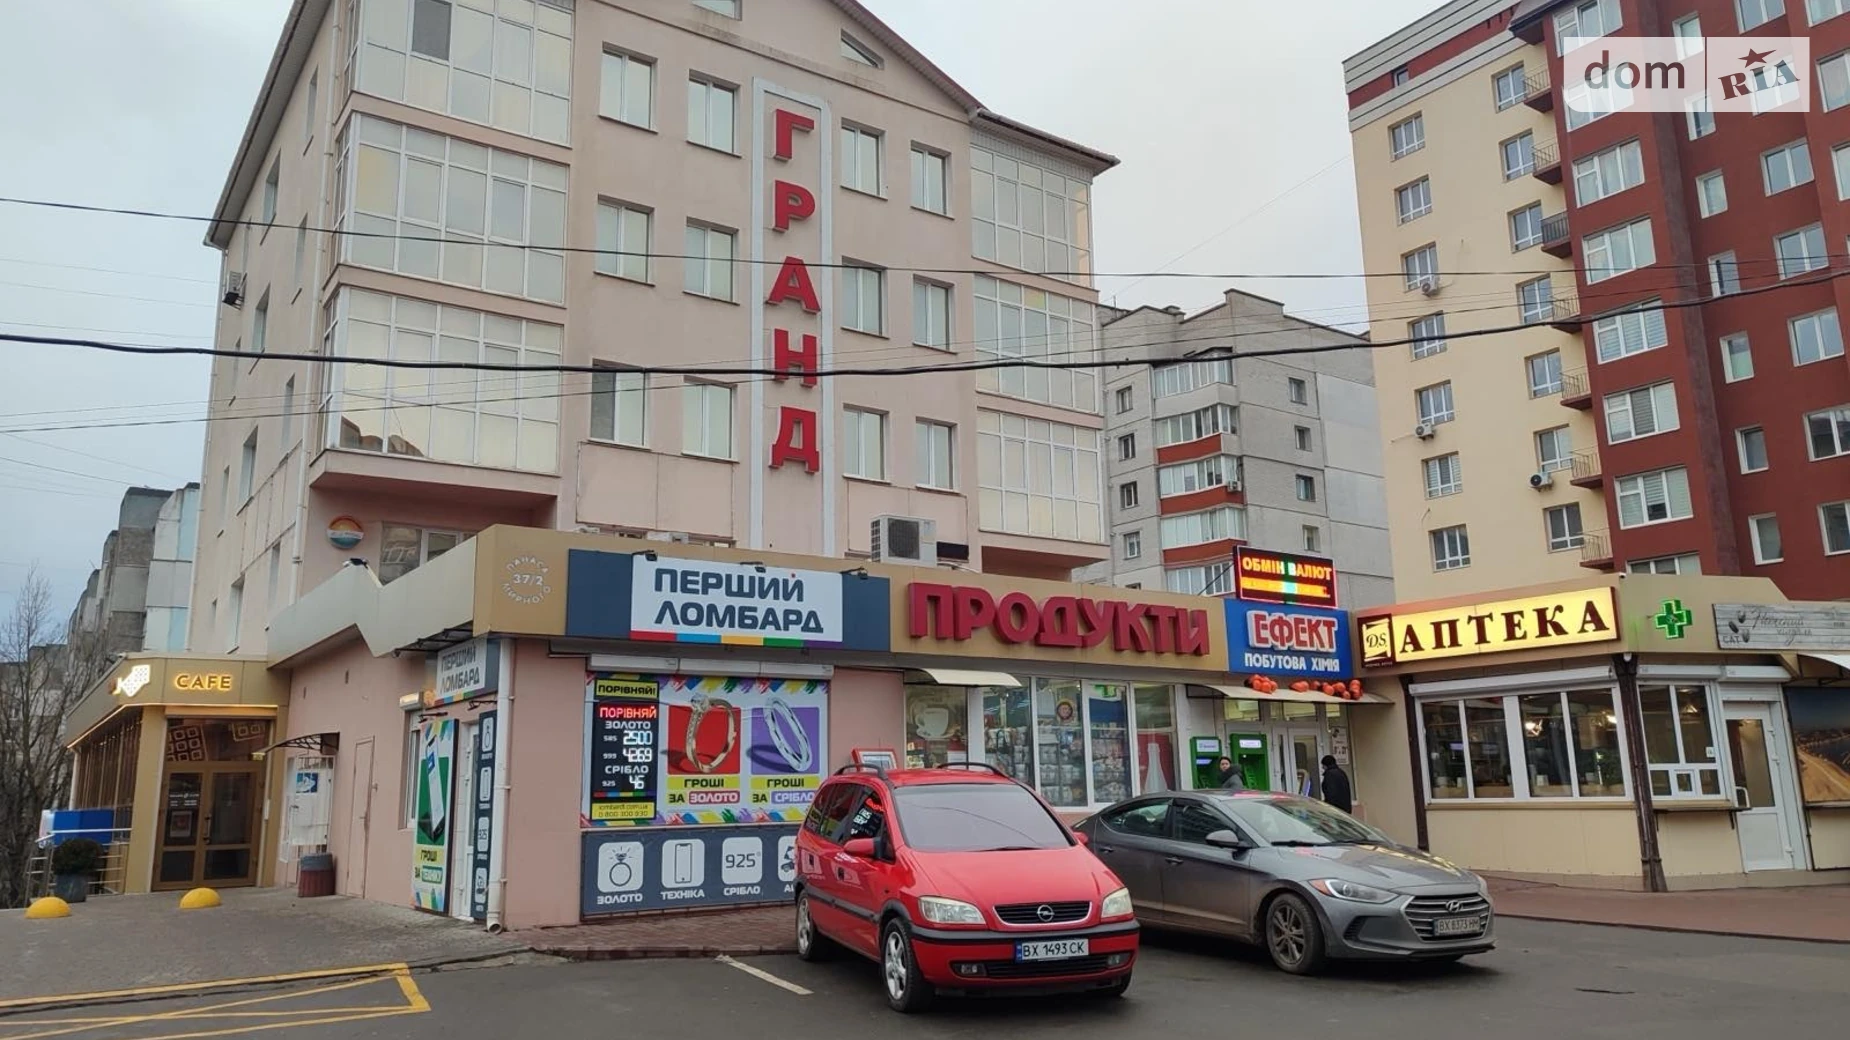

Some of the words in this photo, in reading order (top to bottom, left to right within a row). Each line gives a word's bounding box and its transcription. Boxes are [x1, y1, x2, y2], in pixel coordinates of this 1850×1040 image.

[765, 108, 821, 473] ГРАНД
[1242, 557, 1285, 575] ОБМІН
[1287, 562, 1332, 580] ВАЛЮТ
[513, 574, 543, 586] 37/2
[654, 568, 804, 602] ПЕРШИЙ
[654, 600, 824, 633] ЛОМБАРД
[907, 582, 1211, 656] ПРОДУКТИ
[1248, 611, 1338, 653] ЕФЕКТ
[1399, 599, 1610, 654] АПТЕКА
[441, 643, 476, 674] ПЕРШИЙ
[1244, 652, 1307, 671] ПОБУТОВА
[1311, 657, 1340, 673] ХІМІЯ
[176, 674, 232, 689] CAFE
[440, 667, 480, 694] ЛОМБАРД
[598, 684, 656, 696] ПОРІВНЯЙ!
[600, 706, 657, 719] ПОРІВНЯЙ
[605, 721, 651, 730] ЗОЛОТО
[605, 764, 649, 775] СРІБЛО
[684, 779, 724, 788] ГРОШІ
[767, 779, 804, 788] ГРОШІ
[669, 794, 685, 803] ЗА
[690, 792, 738, 803] ЗОЛОТО
[752, 794, 767, 803] ЗА
[775, 792, 815, 802] СРІБЛО
[661, 889, 705, 900] ТЕХНІКА
[723, 886, 761, 896] СРІБЛО
[597, 893, 643, 904] ЗОЛОТО
[1023, 943, 1039, 958] BX
[1042, 942, 1067, 957] 1493
[1069, 940, 1086, 955] CK
